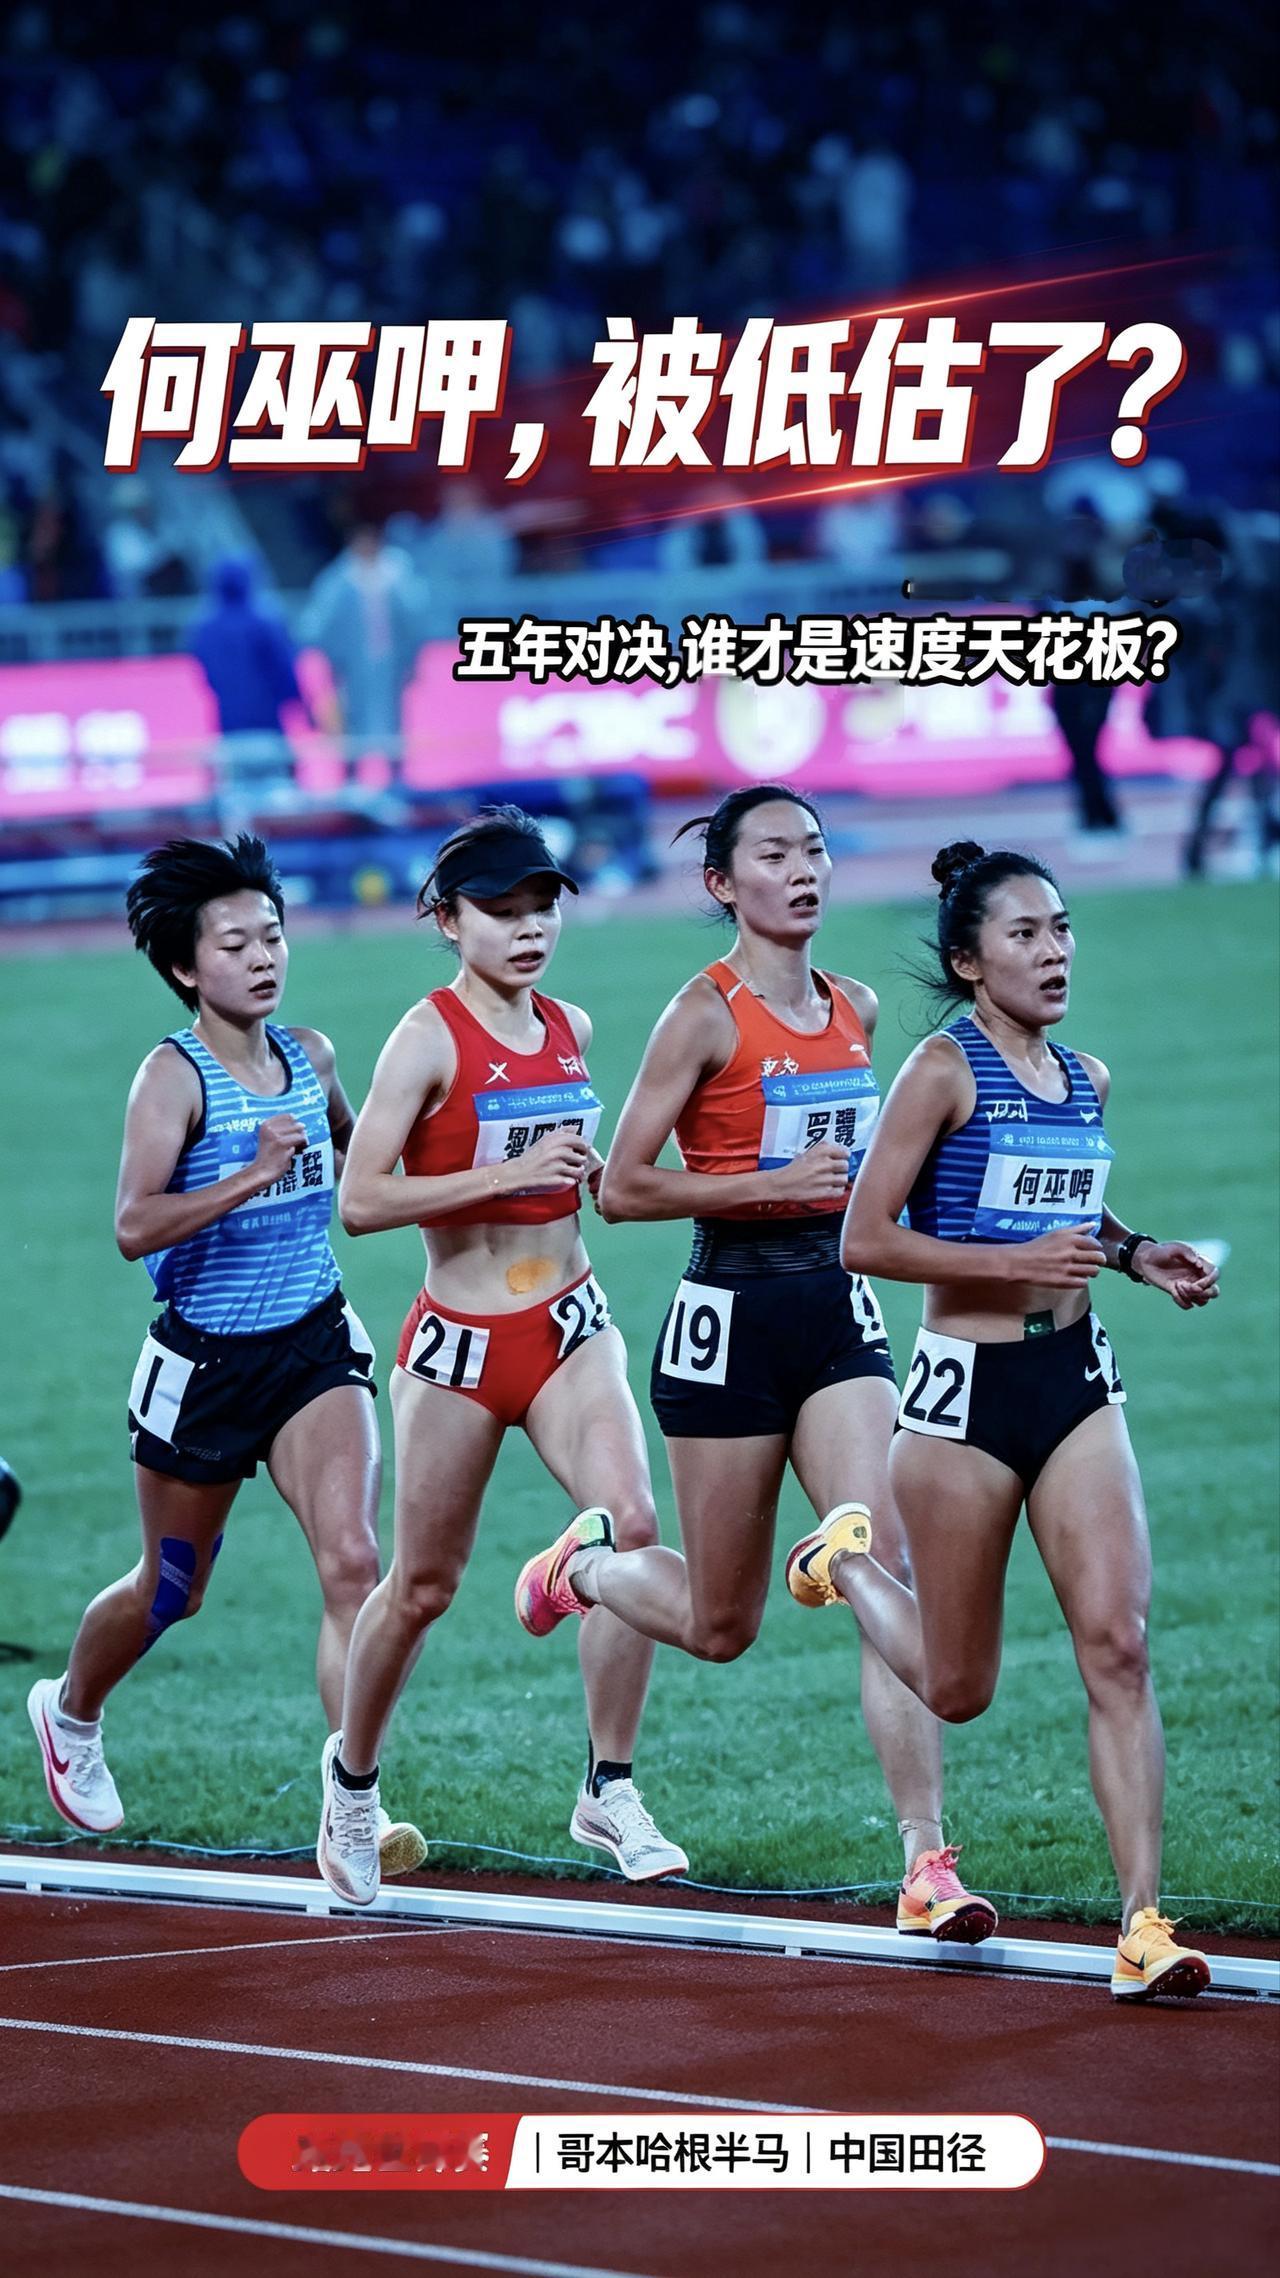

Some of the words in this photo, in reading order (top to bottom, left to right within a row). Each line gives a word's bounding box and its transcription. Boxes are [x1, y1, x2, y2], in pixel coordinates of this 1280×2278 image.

[412, 1315, 472, 1387] 21
[670, 1301, 721, 1371] 19
[139, 1355, 164, 1418] 1
[903, 1349, 965, 1427] 22
